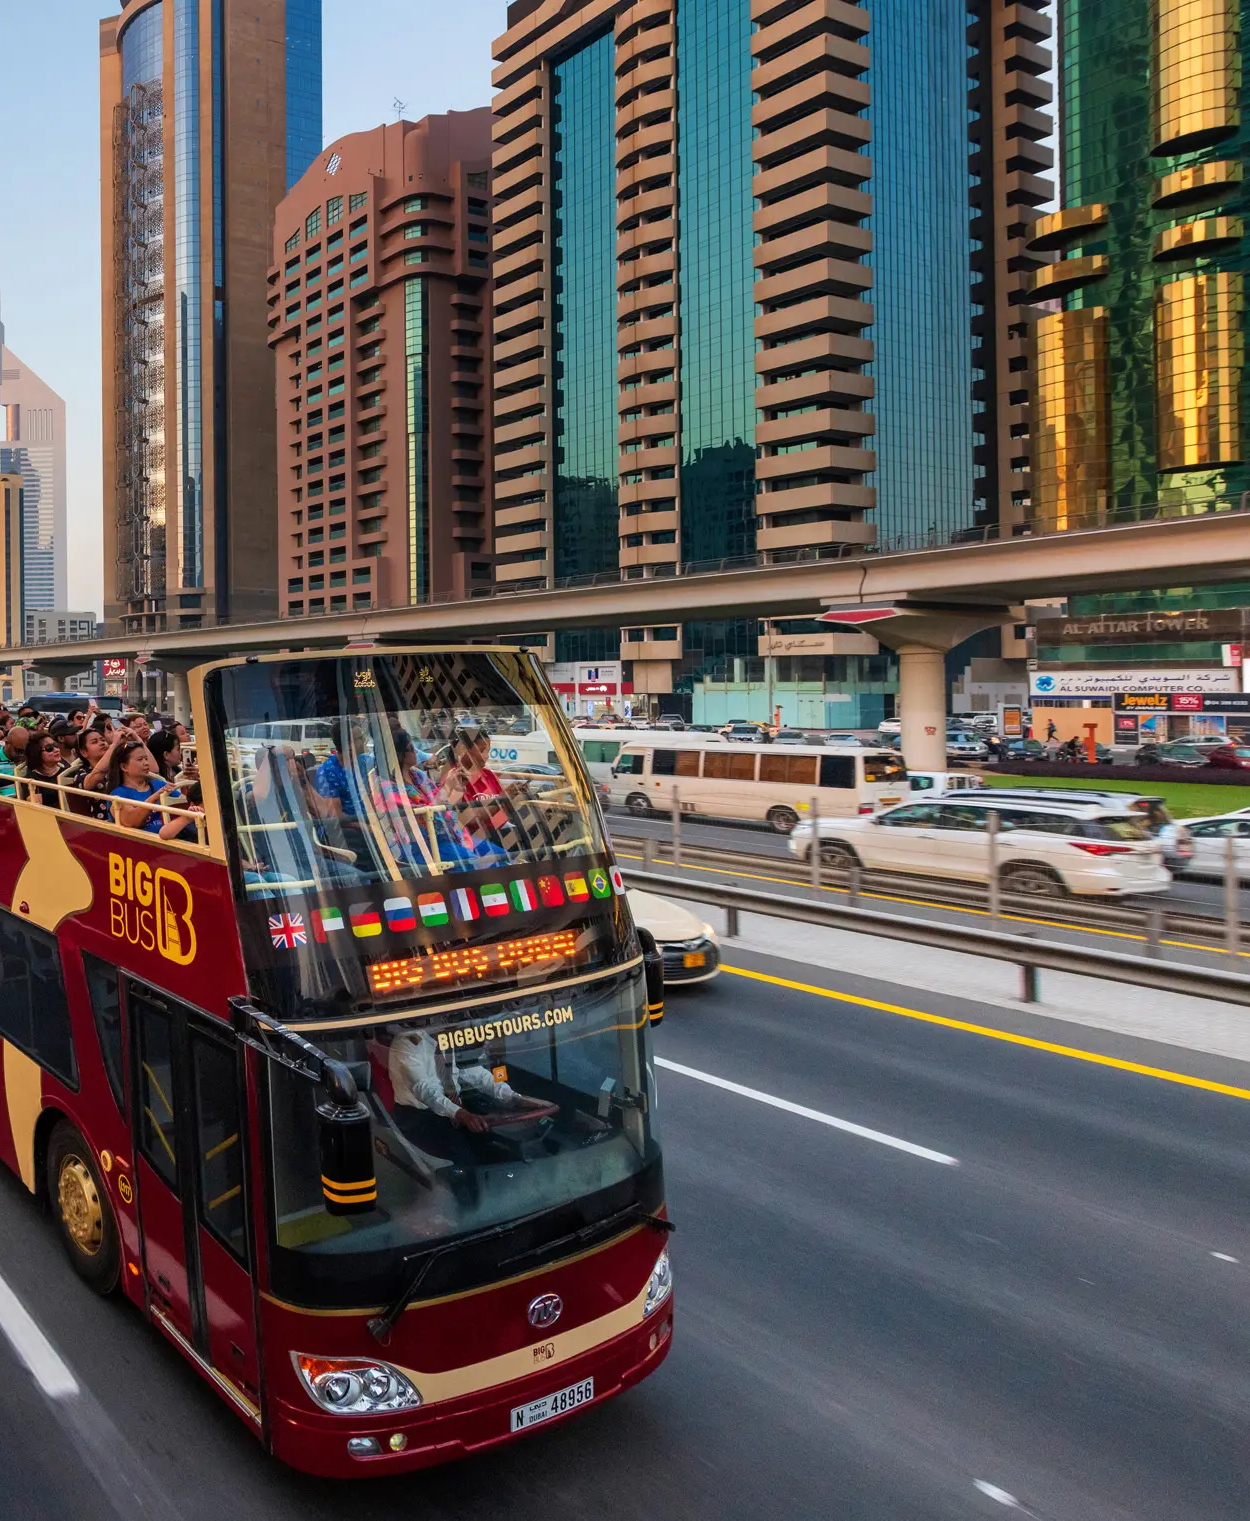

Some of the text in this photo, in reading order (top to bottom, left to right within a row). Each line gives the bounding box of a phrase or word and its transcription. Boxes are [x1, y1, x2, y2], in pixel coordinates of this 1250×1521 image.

[1062, 617, 1209, 635] AL ATTAR TOWER
[1121, 693, 1168, 706] Jewelz
[490, 747, 518, 760] OUQ
[108, 851, 154, 907] BIG
[110, 897, 156, 951] BUS
[437, 1005, 574, 1051] BIGBUSTOURS.COM
[533, 1345, 545, 1357] BIG
[516, 1381, 592, 1428] N 48956
[529, 1410, 548, 1423] DUBAI
